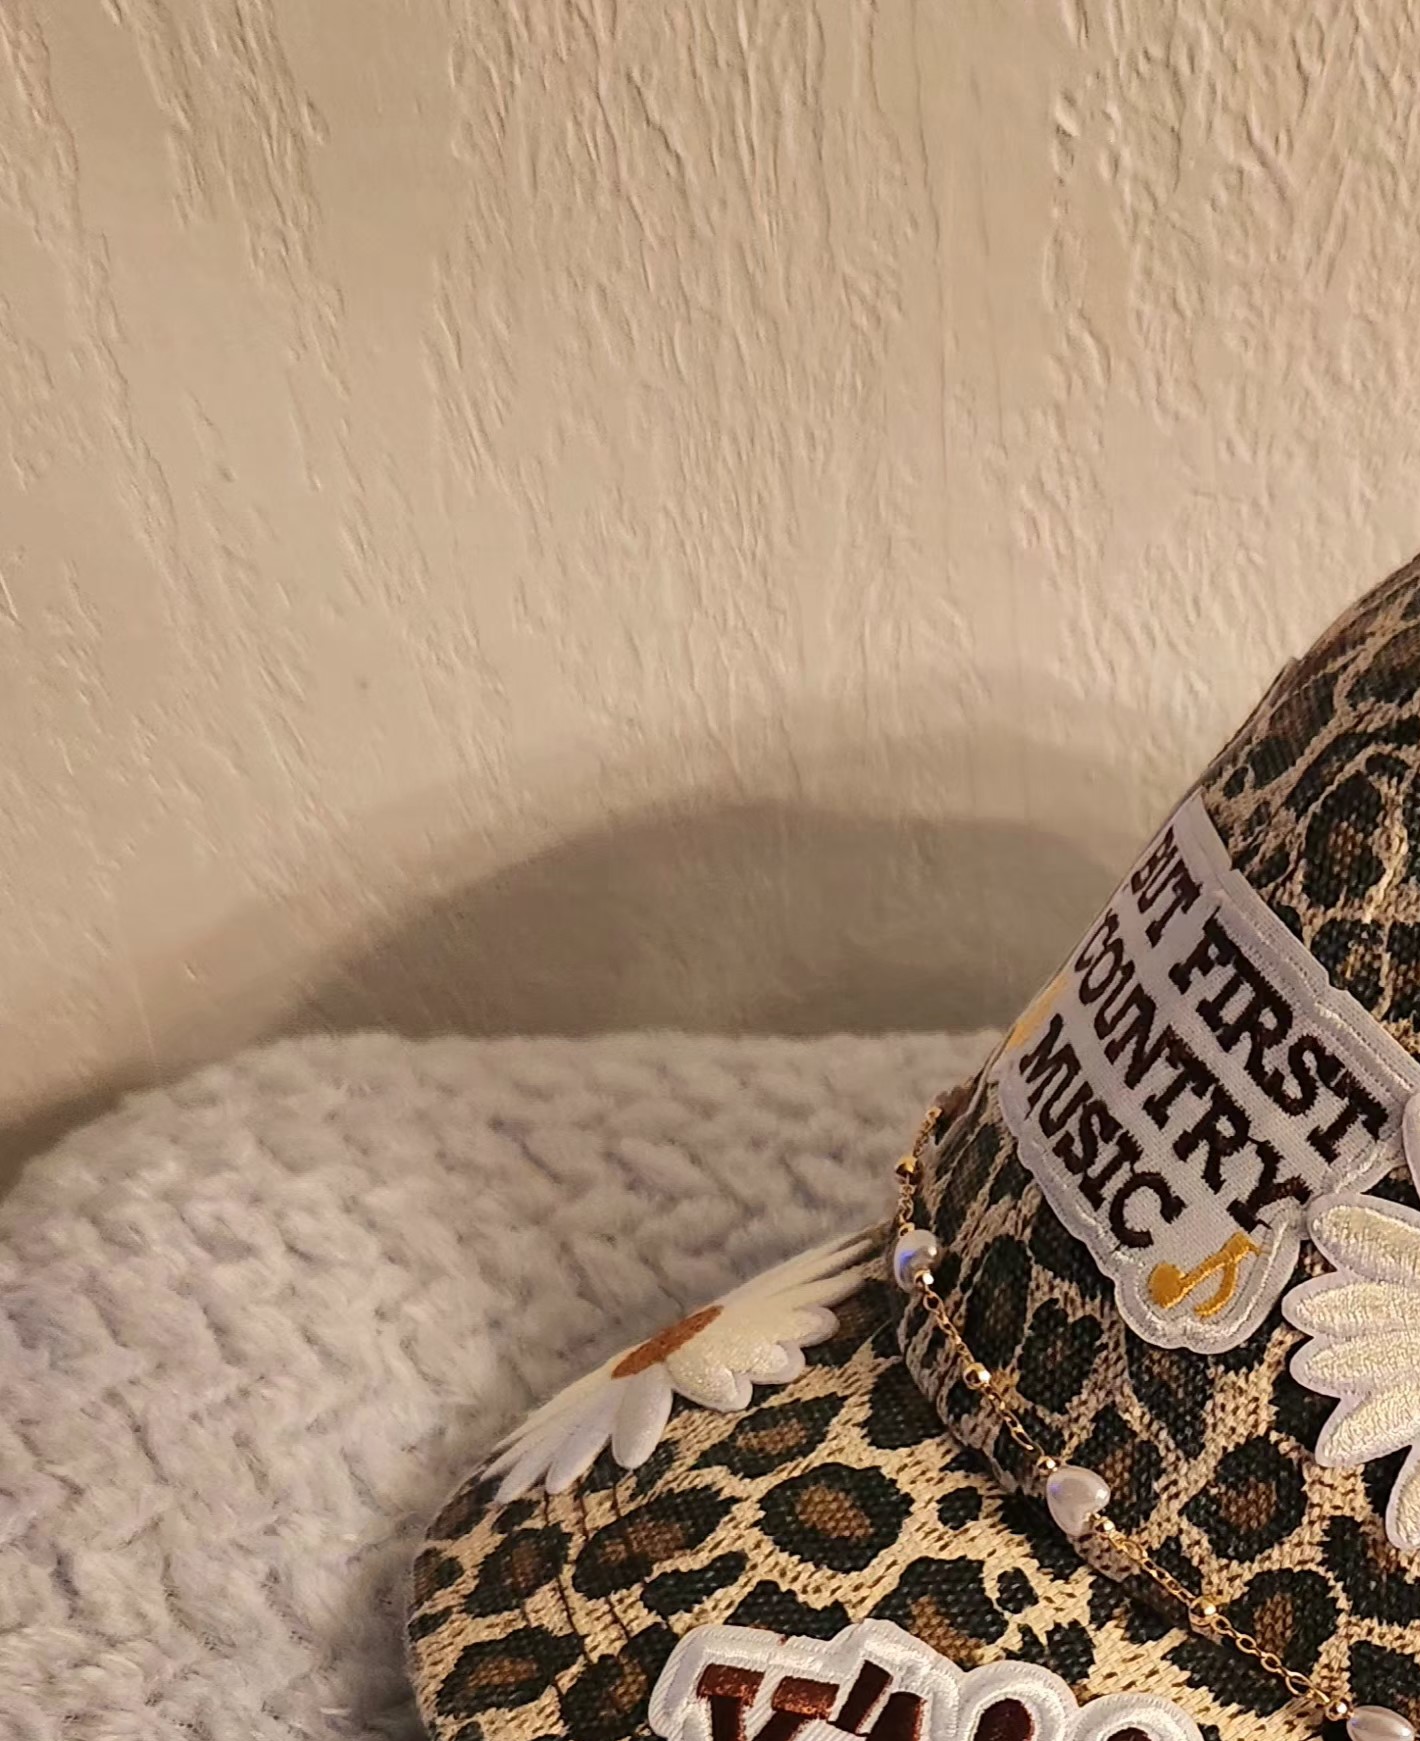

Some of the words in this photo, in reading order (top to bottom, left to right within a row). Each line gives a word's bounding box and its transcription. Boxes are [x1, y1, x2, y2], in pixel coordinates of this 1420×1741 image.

[1019, 1013, 1187, 1249] MUSIC
[1074, 908, 1311, 1233] COUNTRY
[1131, 826, 1203, 948] BUT
[1168, 911, 1390, 1163] FIRST
